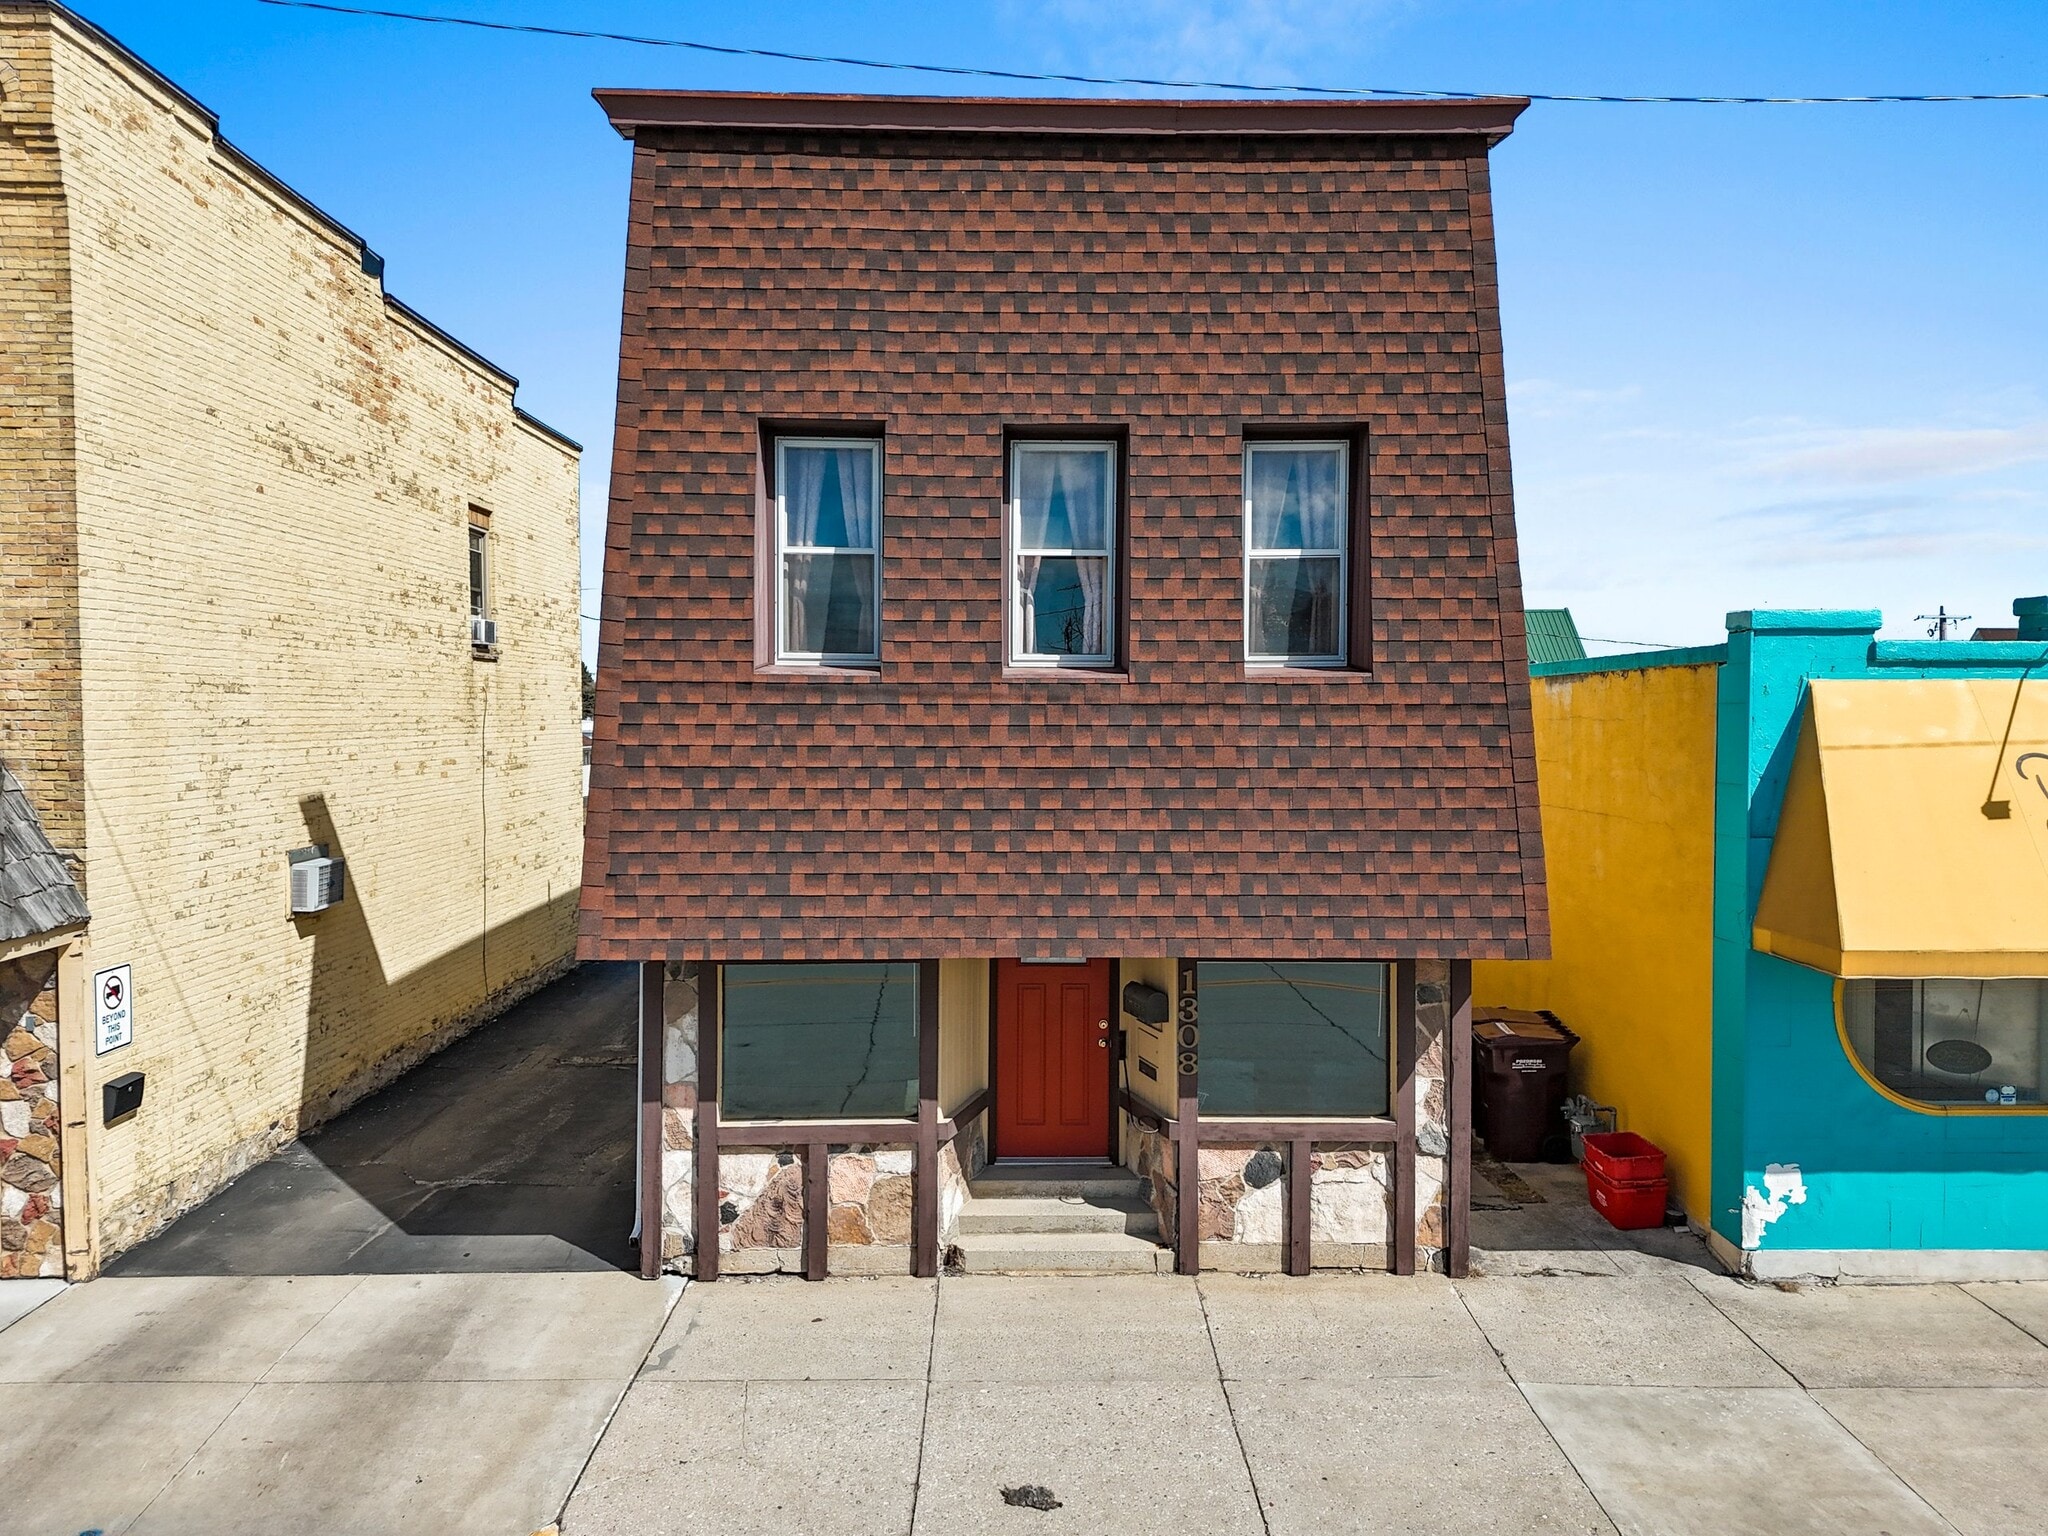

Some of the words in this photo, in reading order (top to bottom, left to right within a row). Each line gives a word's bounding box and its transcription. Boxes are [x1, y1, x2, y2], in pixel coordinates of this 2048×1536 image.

[102, 1009, 126, 1025] BEYOND
[1178, 970, 1198, 1076] 1308
[107, 1022, 121, 1033] THIS
[105, 1032, 122, 1046] POINT
